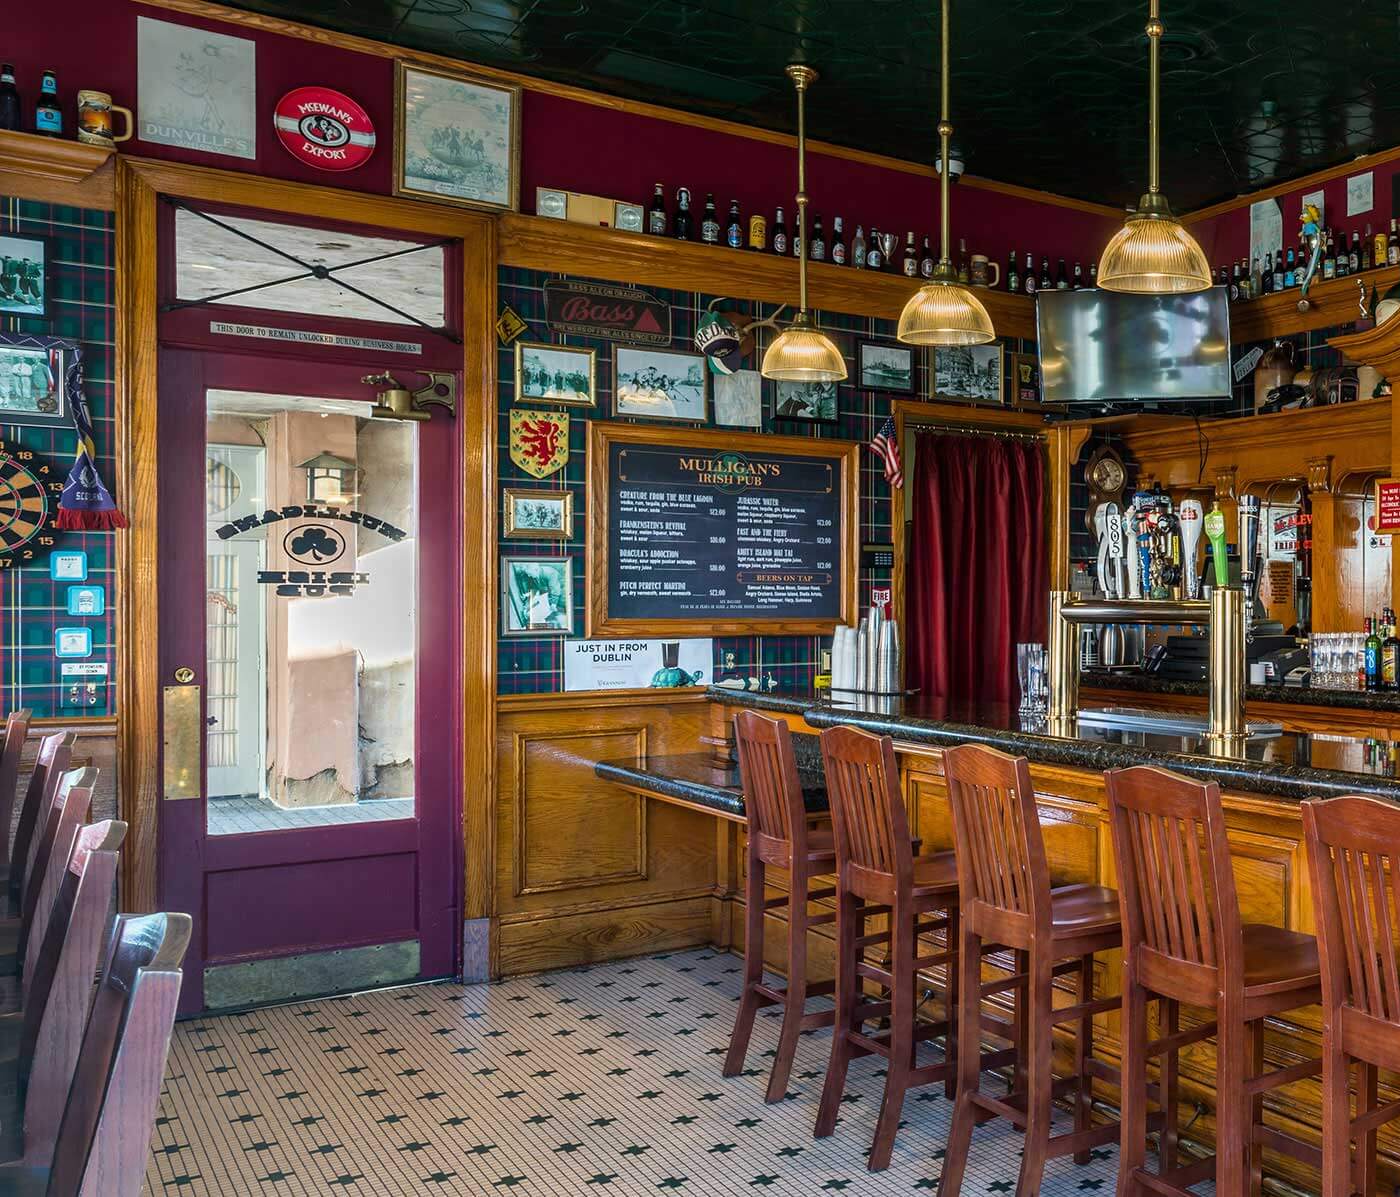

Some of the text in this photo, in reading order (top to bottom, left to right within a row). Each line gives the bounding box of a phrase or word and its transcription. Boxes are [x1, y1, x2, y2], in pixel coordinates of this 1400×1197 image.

[146, 124, 248, 150] DUNVILLE'S
[302, 142, 346, 160] EXPORT
[561, 296, 637, 323] Bass
[216, 324, 417, 352] THIS DOOR TO REMAIN UNLOCKED DURING BUSINESS HOURS
[17, 452, 33, 460] 18
[39, 465, 49, 474] 4
[680, 458, 781, 476] MULLIGAN'S
[698, 474, 762, 486] IRISH PUB
[48, 483, 64, 492] 13
[620, 491, 647, 499] CREATURE
[678, 494, 692, 502] BLUE
[693, 495, 714, 503] LAGOON
[620, 520, 664, 530] FRANKENSTEIN'S
[763, 528, 773, 537] THE
[38, 536, 54, 546] 15
[24, 550, 33, 559] 2
[620, 549, 648, 558] DRACULA'S
[620, 581, 637, 590] PITCH
[639, 582, 662, 590] PERFECT
[576, 643, 648, 653] JUST IN FROM
[593, 653, 632, 662] DUBLIN
